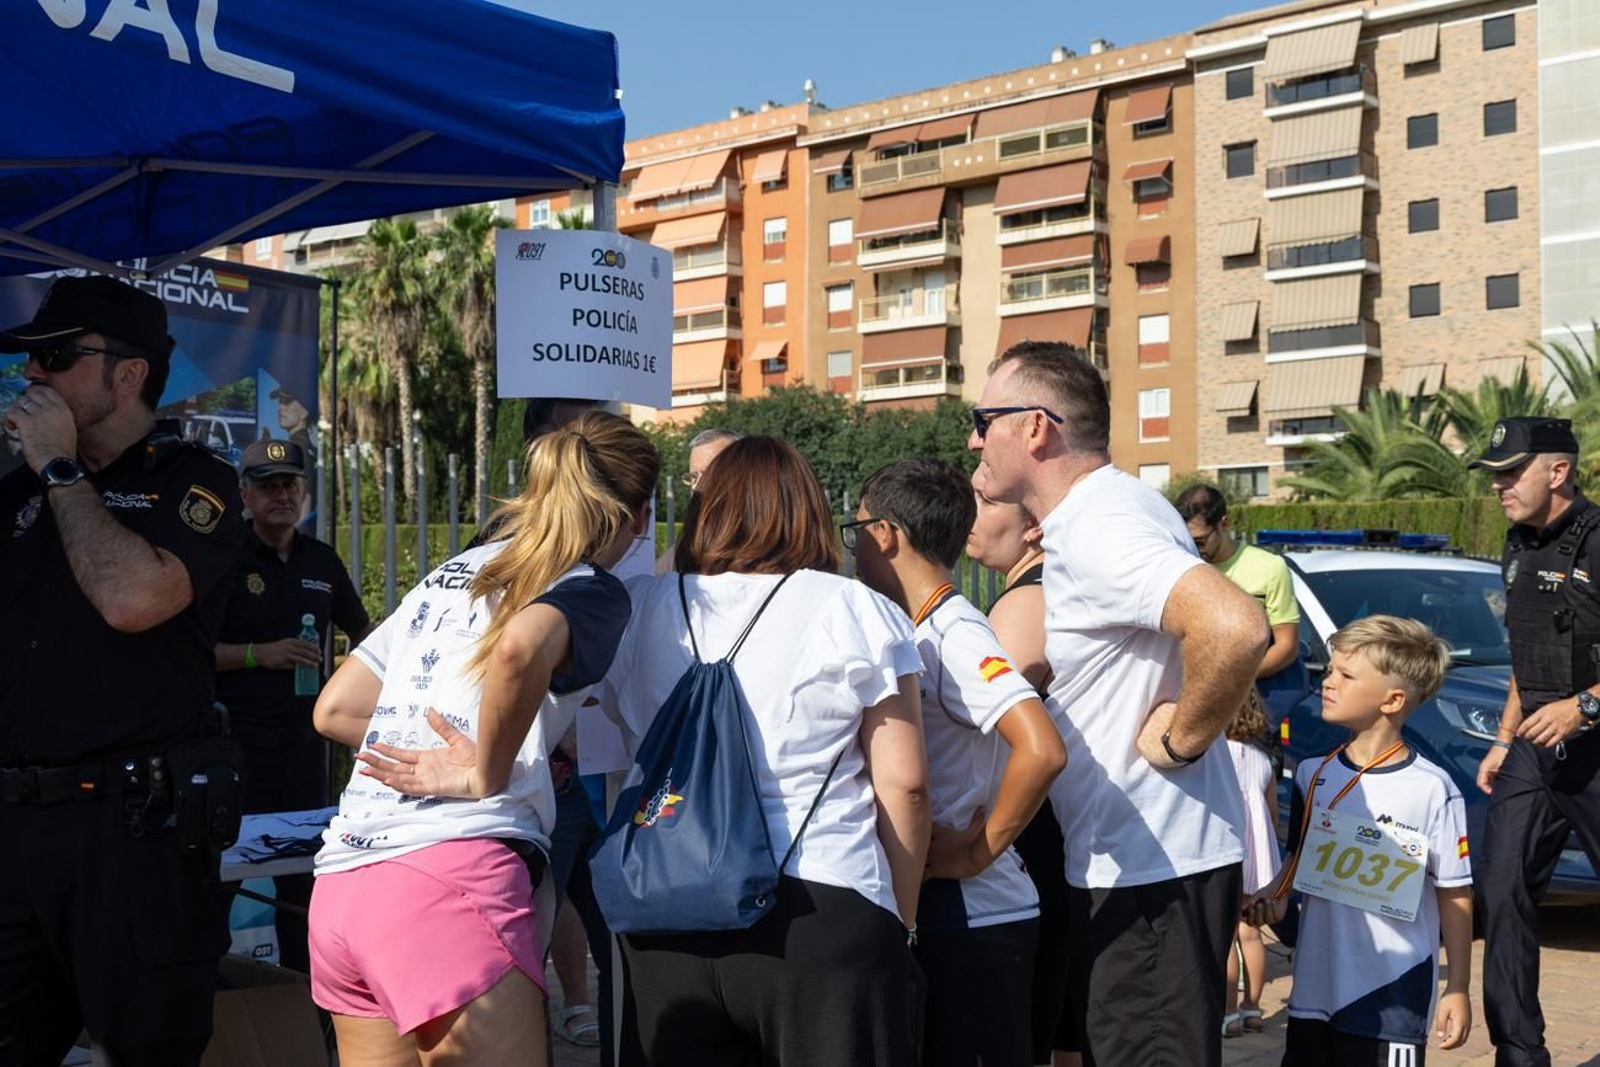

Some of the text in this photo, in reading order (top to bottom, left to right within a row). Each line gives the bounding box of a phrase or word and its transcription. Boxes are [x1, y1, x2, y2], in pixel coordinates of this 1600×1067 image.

[560, 272, 644, 301] PULSERAS
[572, 308, 638, 335] POLICÍA
[532, 343, 657, 373] SOLIDARIAS 1€
[1315, 840, 1420, 893] 1037
